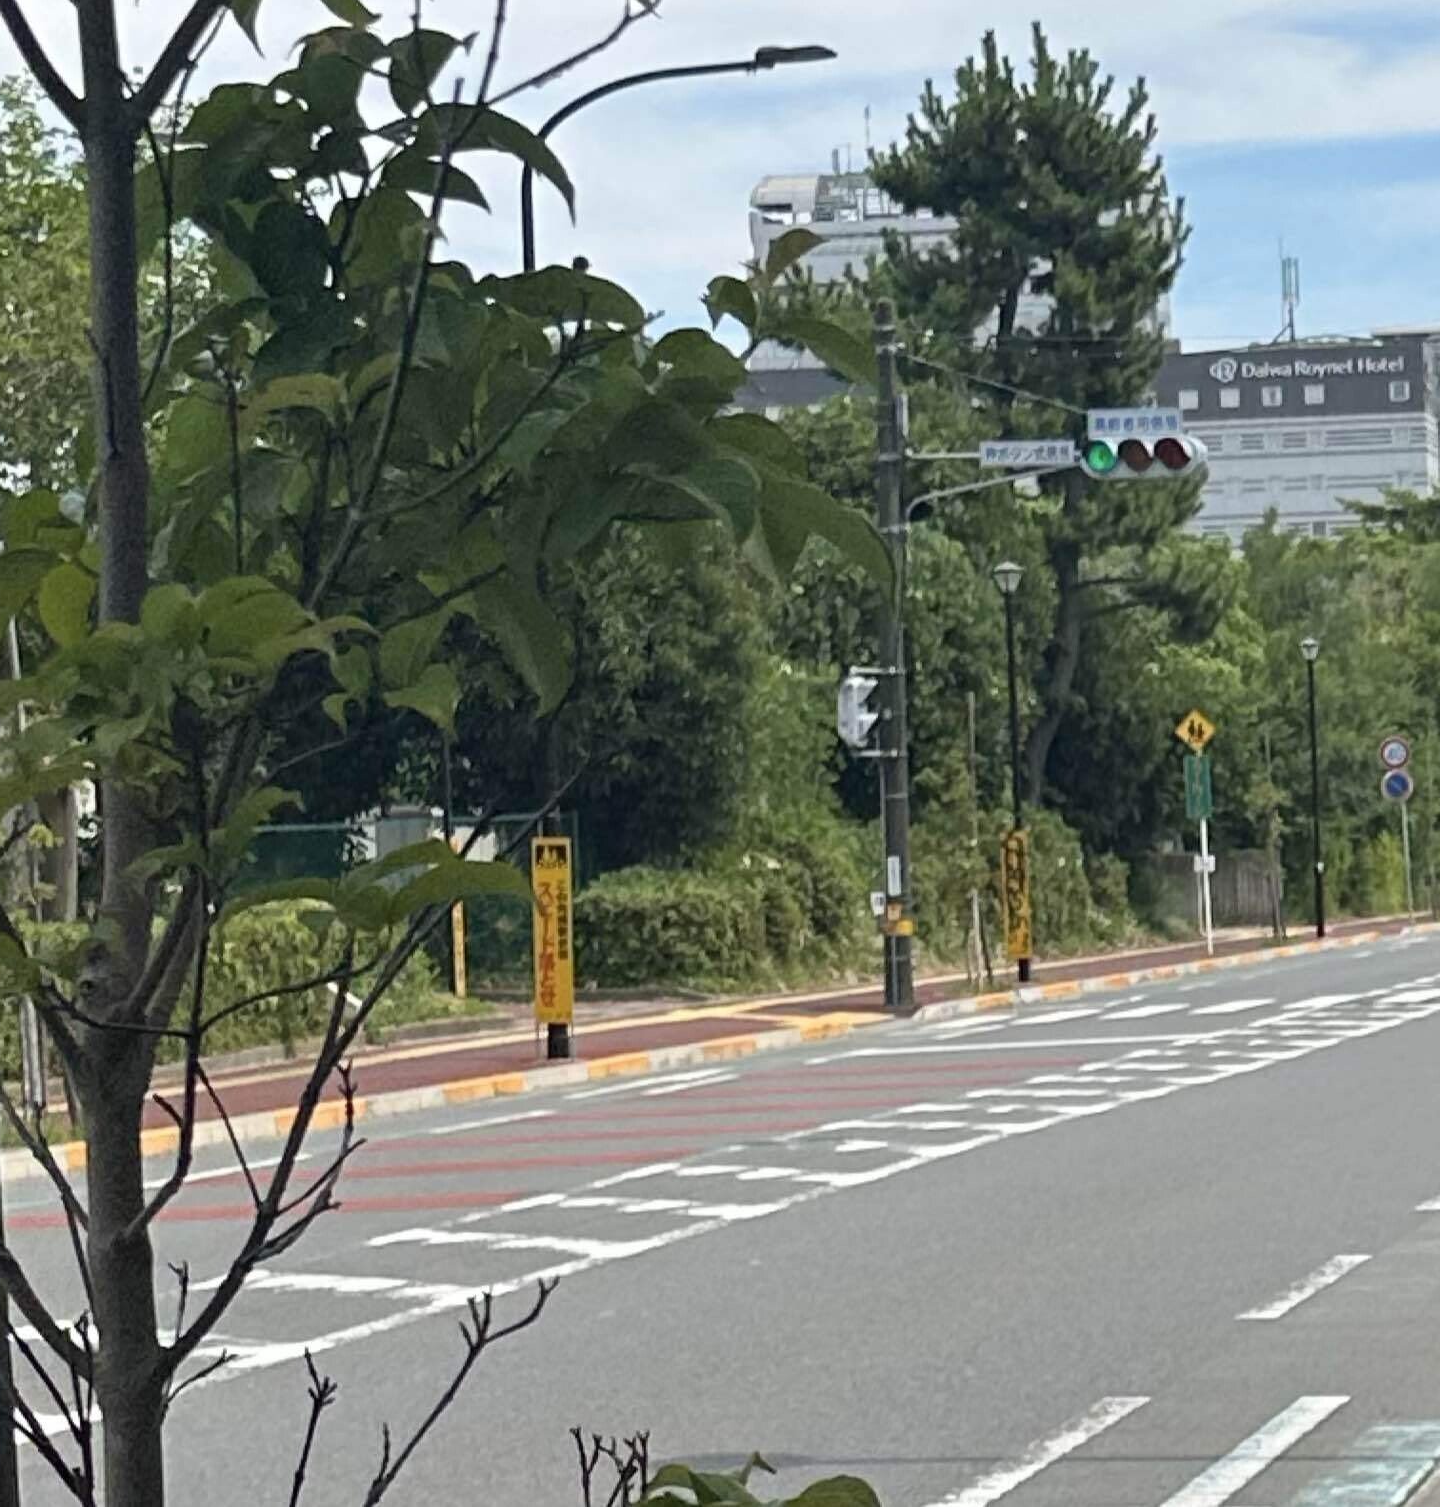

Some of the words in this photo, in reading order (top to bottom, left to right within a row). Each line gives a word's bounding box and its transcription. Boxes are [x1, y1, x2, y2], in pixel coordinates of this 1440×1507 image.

[1241, 362, 1292, 378] Daiwa
[1295, 359, 1353, 379] Roynet
[1357, 356, 1405, 374] Hotel
